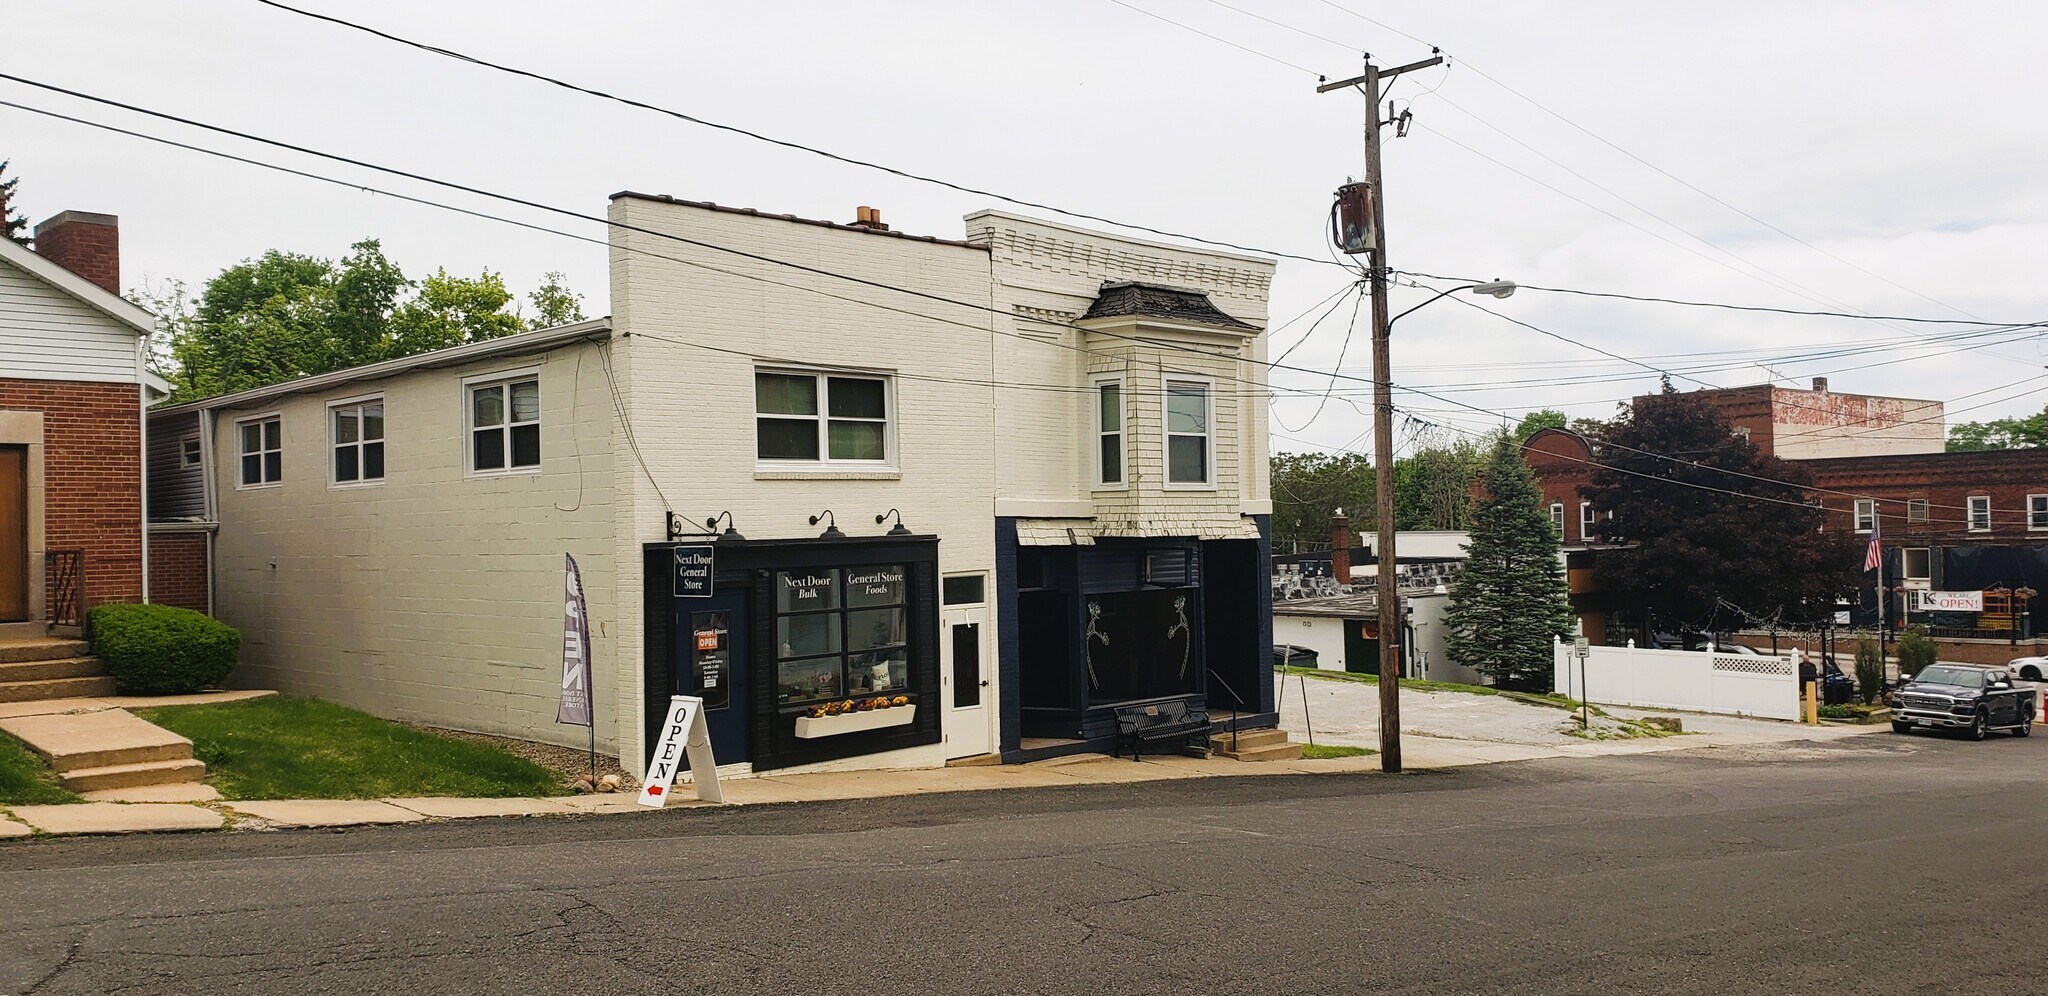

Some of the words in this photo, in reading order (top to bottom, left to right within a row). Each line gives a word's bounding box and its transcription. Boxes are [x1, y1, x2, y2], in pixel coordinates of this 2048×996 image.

[676, 553, 692, 564] Next
[693, 553, 712, 564] Door
[680, 565, 707, 577] General
[684, 578, 703, 589] Store
[784, 576, 806, 588] Next
[807, 575, 831, 587] Door
[848, 572, 881, 584] General
[881, 572, 903, 582] Store
[798, 588, 818, 599] Bulk
[865, 584, 888, 595] Foods
[1940, 599, 1978, 609] OPEN!
[693, 629, 714, 637] General
[700, 638, 717, 647] OPEN
[654, 707, 687, 779] OPEN
